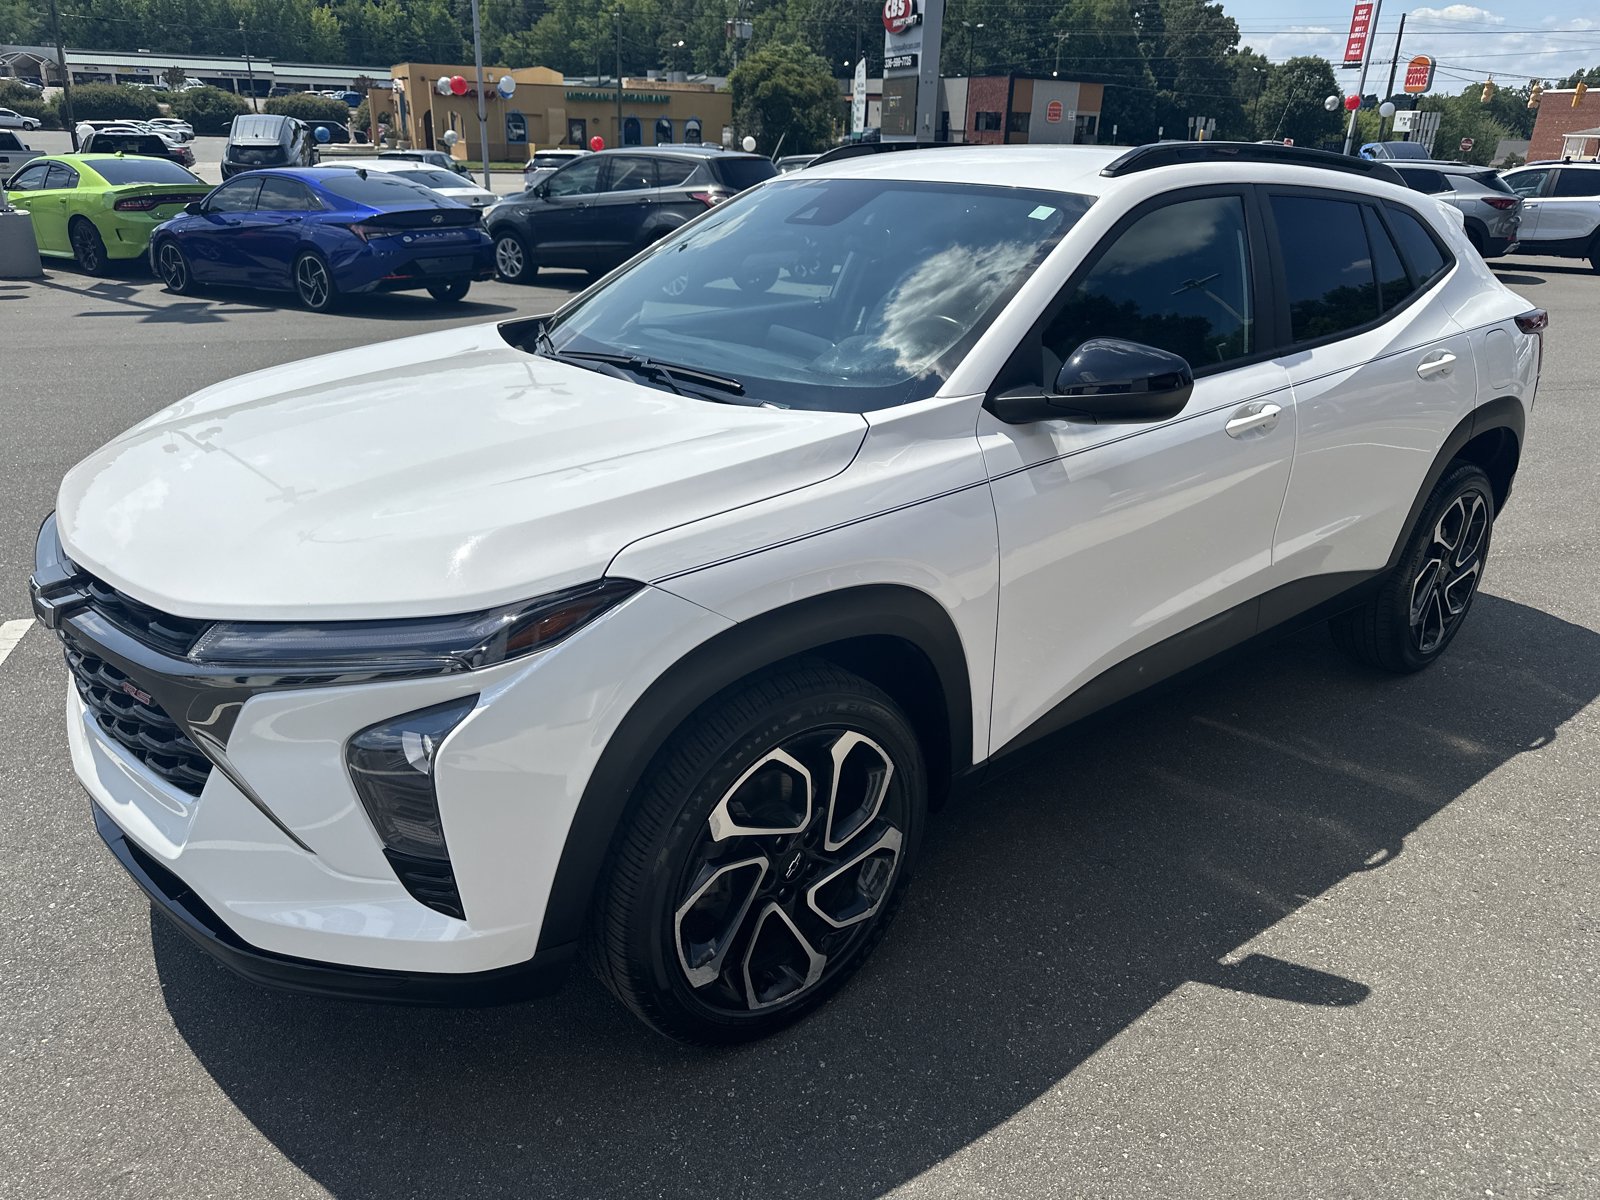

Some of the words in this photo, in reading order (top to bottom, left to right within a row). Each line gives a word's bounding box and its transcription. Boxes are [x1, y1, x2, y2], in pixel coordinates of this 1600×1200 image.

[885, 0, 905, 19] CBS
[1407, 66, 1429, 75] BURGER
[1405, 74, 1428, 86] KING
[120, 681, 152, 705] RS
